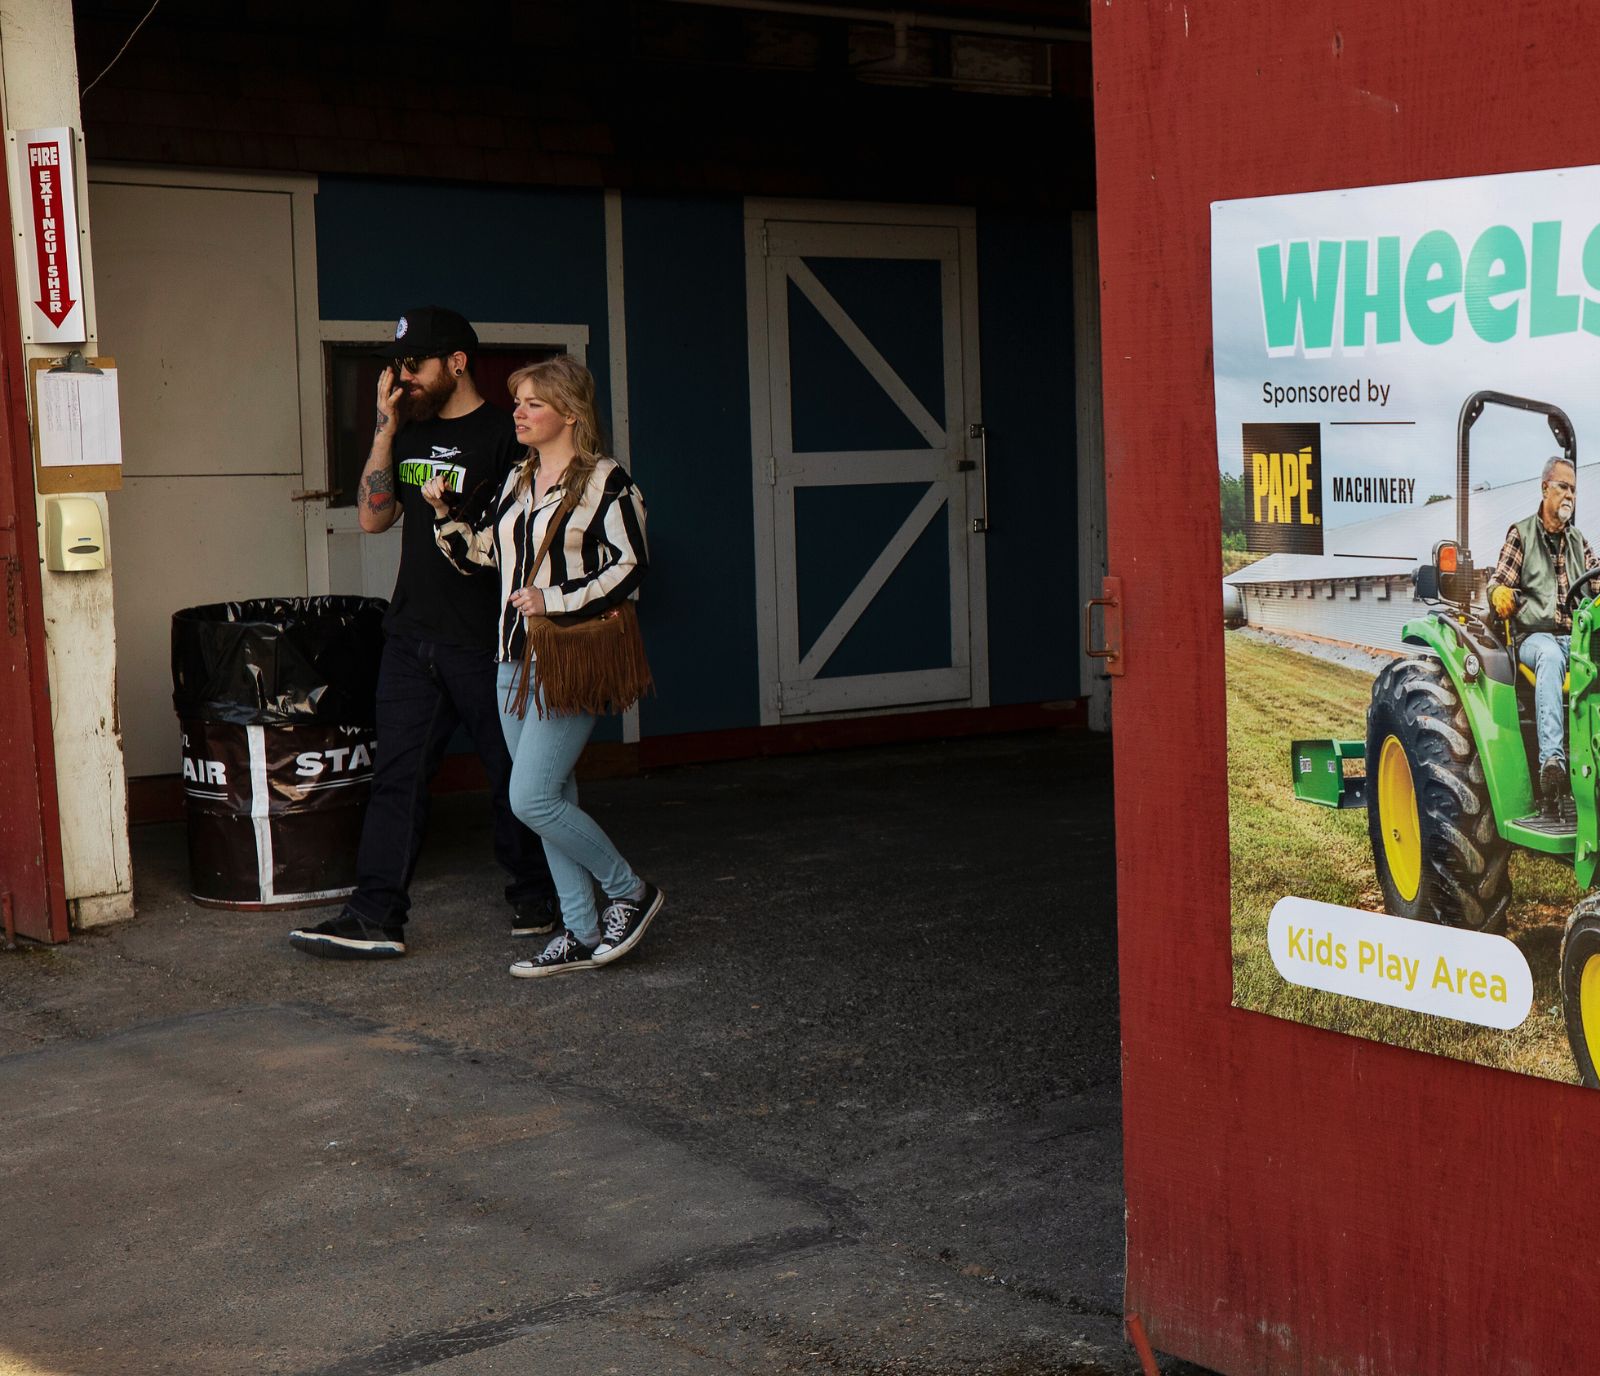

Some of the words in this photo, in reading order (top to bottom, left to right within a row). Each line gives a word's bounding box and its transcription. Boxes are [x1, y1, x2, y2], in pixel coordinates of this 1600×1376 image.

[30, 146, 58, 167] FIRE
[39, 170, 62, 313] EXTINGUISHER
[1262, 379, 1361, 408] Sponsored
[1367, 379, 1391, 407] by
[1332, 477, 1416, 504] MACHINERY
[295, 741, 377, 777] STA
[1287, 925, 1348, 970] Kids
[1358, 940, 1420, 992] Play
[1431, 956, 1508, 1004] Area
